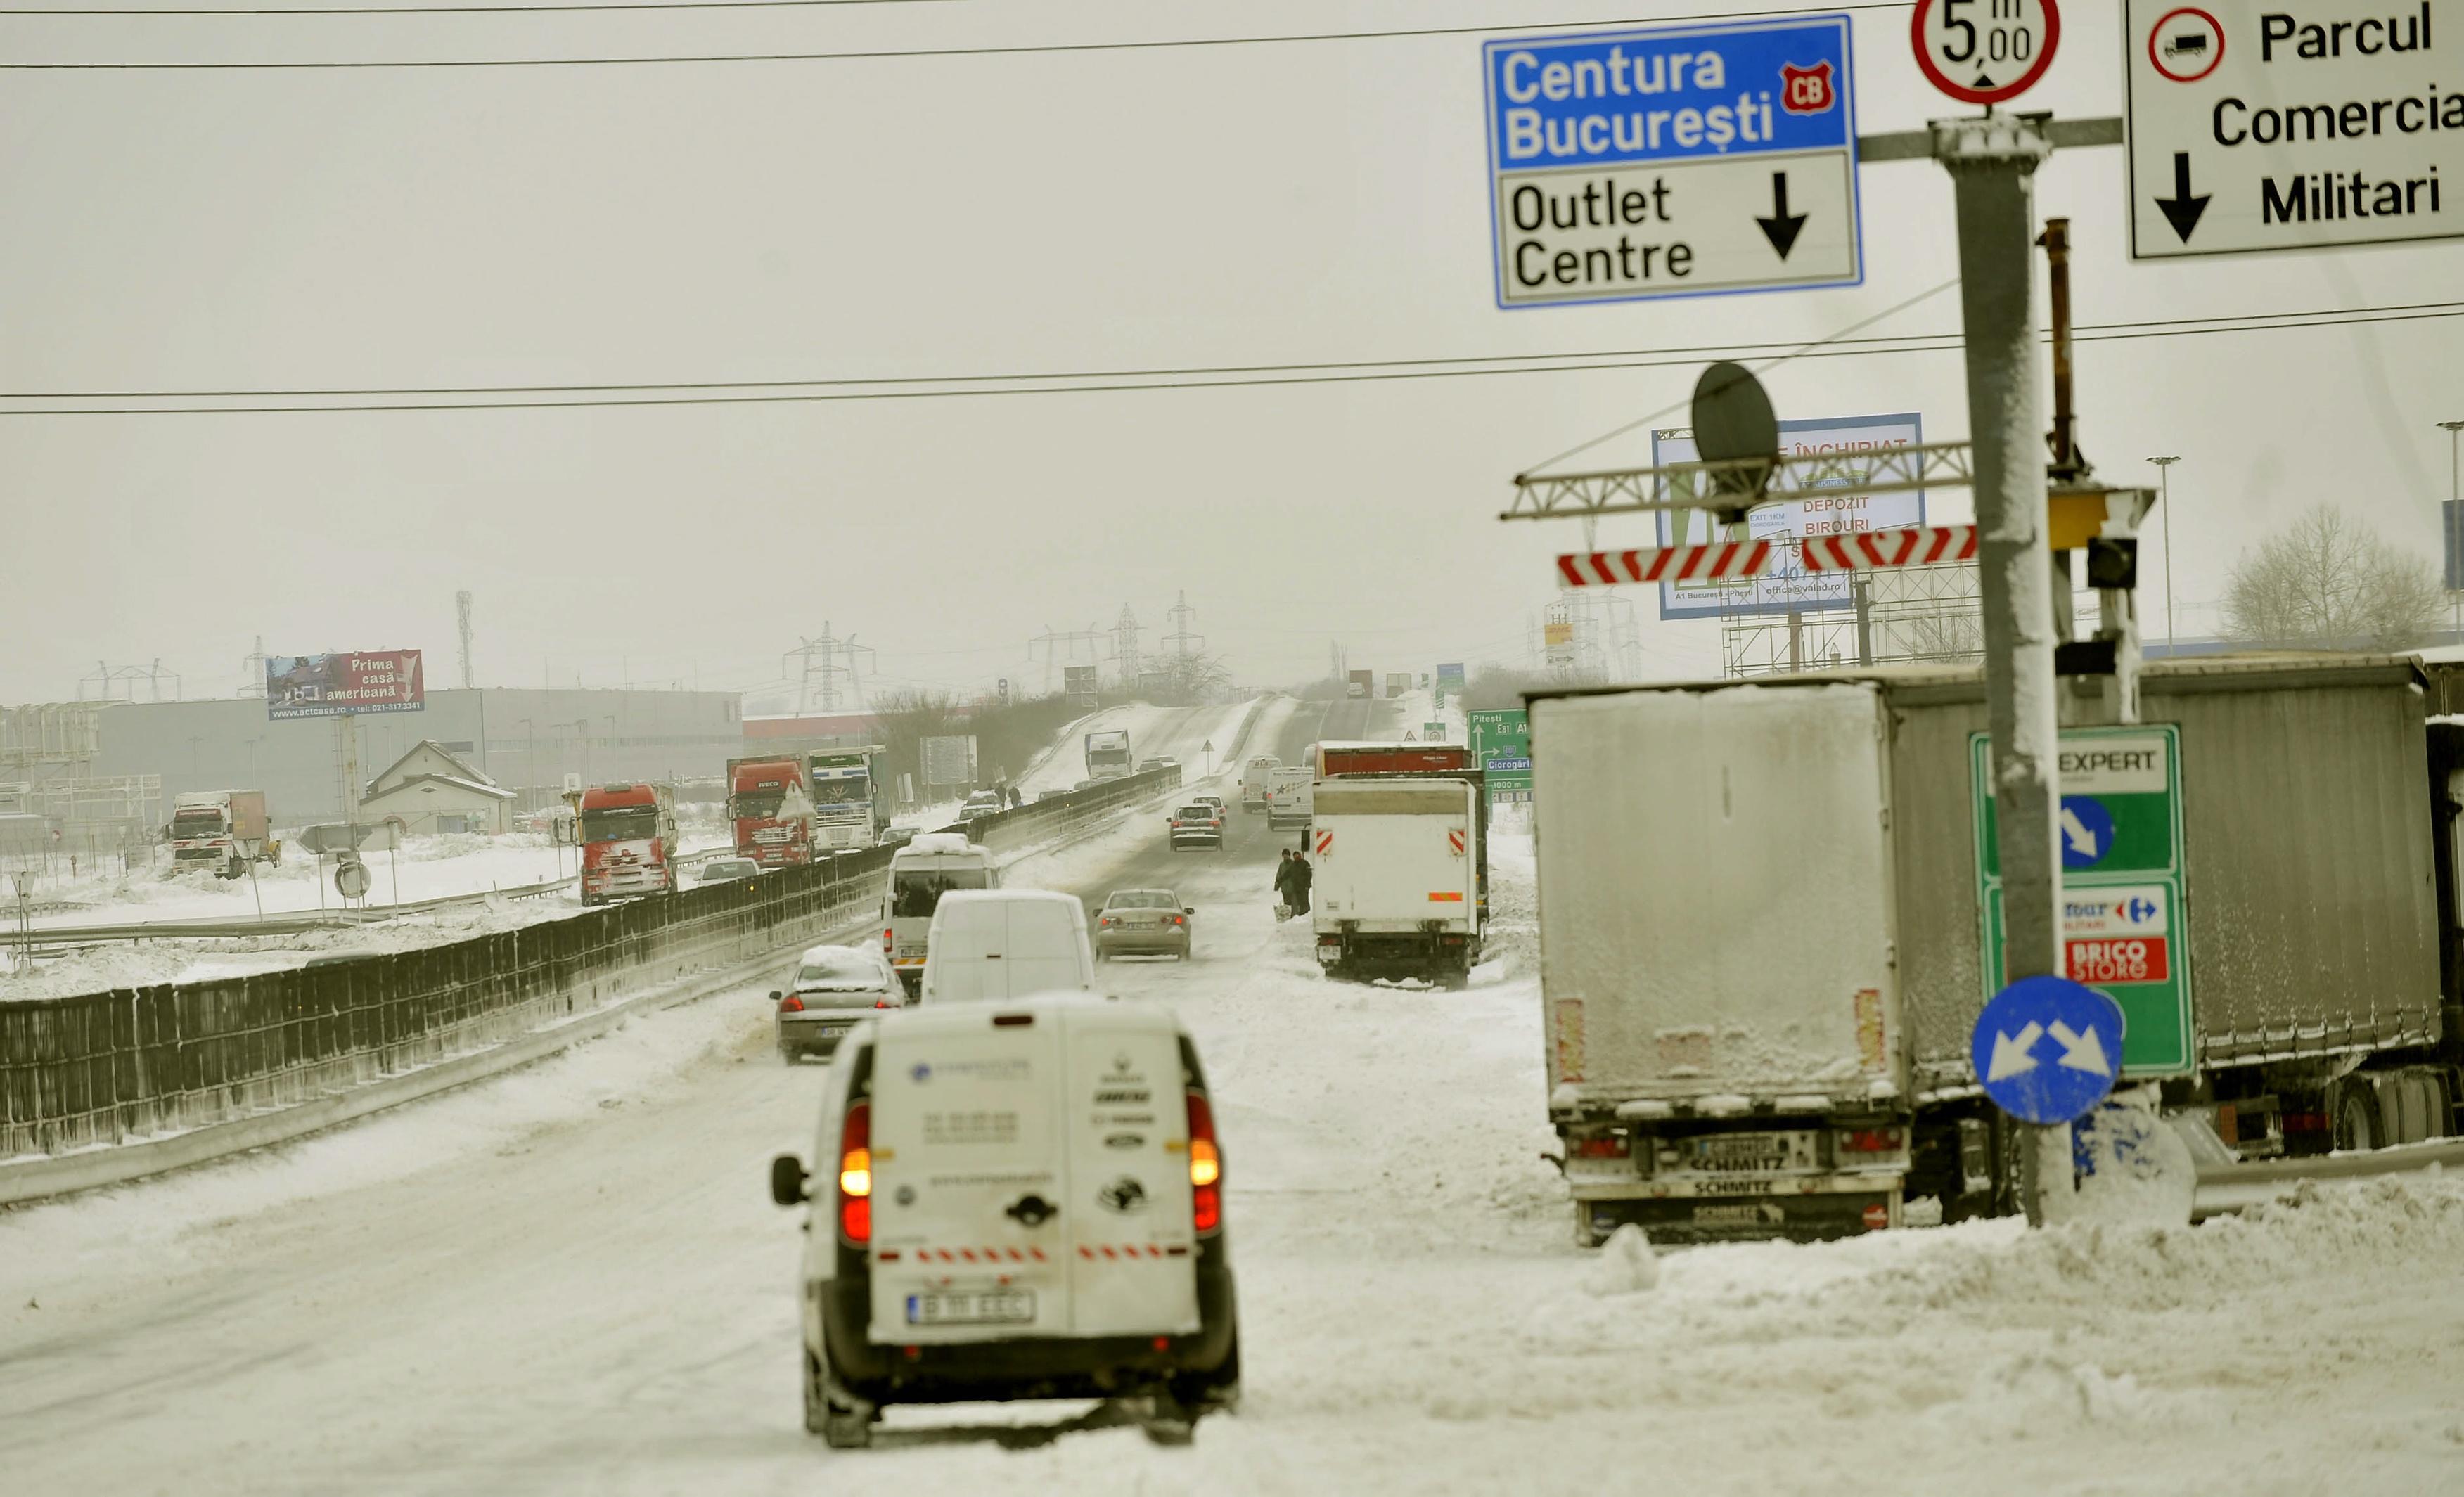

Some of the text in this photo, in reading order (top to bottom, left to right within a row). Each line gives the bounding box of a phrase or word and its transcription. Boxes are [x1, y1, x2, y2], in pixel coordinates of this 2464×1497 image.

[1943, 0, 2031, 69] 5,00
[2261, 2, 2432, 62] Parcul
[1503, 46, 1725, 103] Centura
[1791, 77, 1823, 105] CB
[1505, 92, 1773, 160] București
[1512, 178, 1670, 231] Outlet
[2263, 166, 2439, 224] Militari
[1516, 235, 1693, 287] Centre
[1804, 497, 1869, 513] DEPOZIT
[1805, 520, 1869, 534] BIROURI
[352, 659, 394, 672] Prima
[362, 673, 394, 684] casă
[326, 686, 396, 700] americană
[273, 706, 346, 717] www.actcasa.ro
[1489, 760, 1532, 770] Ciorogârl
[2059, 751, 2157, 771] EXPERT
[2072, 940, 2147, 963] BRICO
[1690, 1157, 1783, 1171] SCHMITZ
